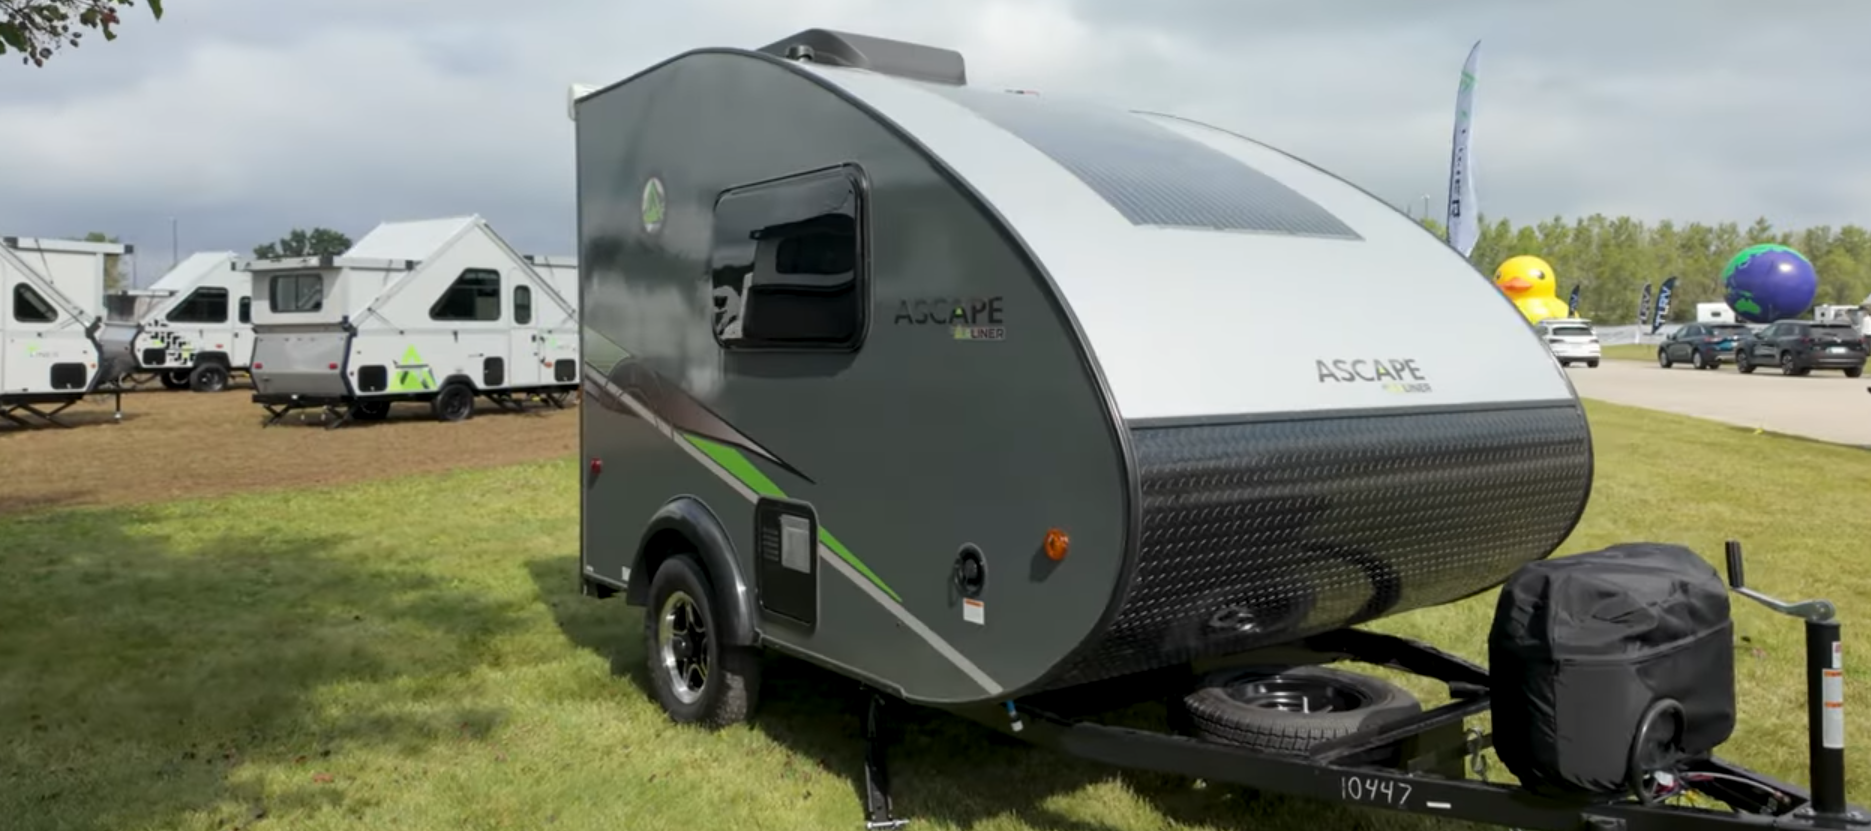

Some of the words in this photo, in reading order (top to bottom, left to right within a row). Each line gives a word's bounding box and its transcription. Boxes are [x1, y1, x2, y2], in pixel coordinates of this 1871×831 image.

[894, 296, 1003, 325] ASCAPE
[1315, 358, 1426, 383] ASCAPE
[1341, 776, 1413, 805] 10447
